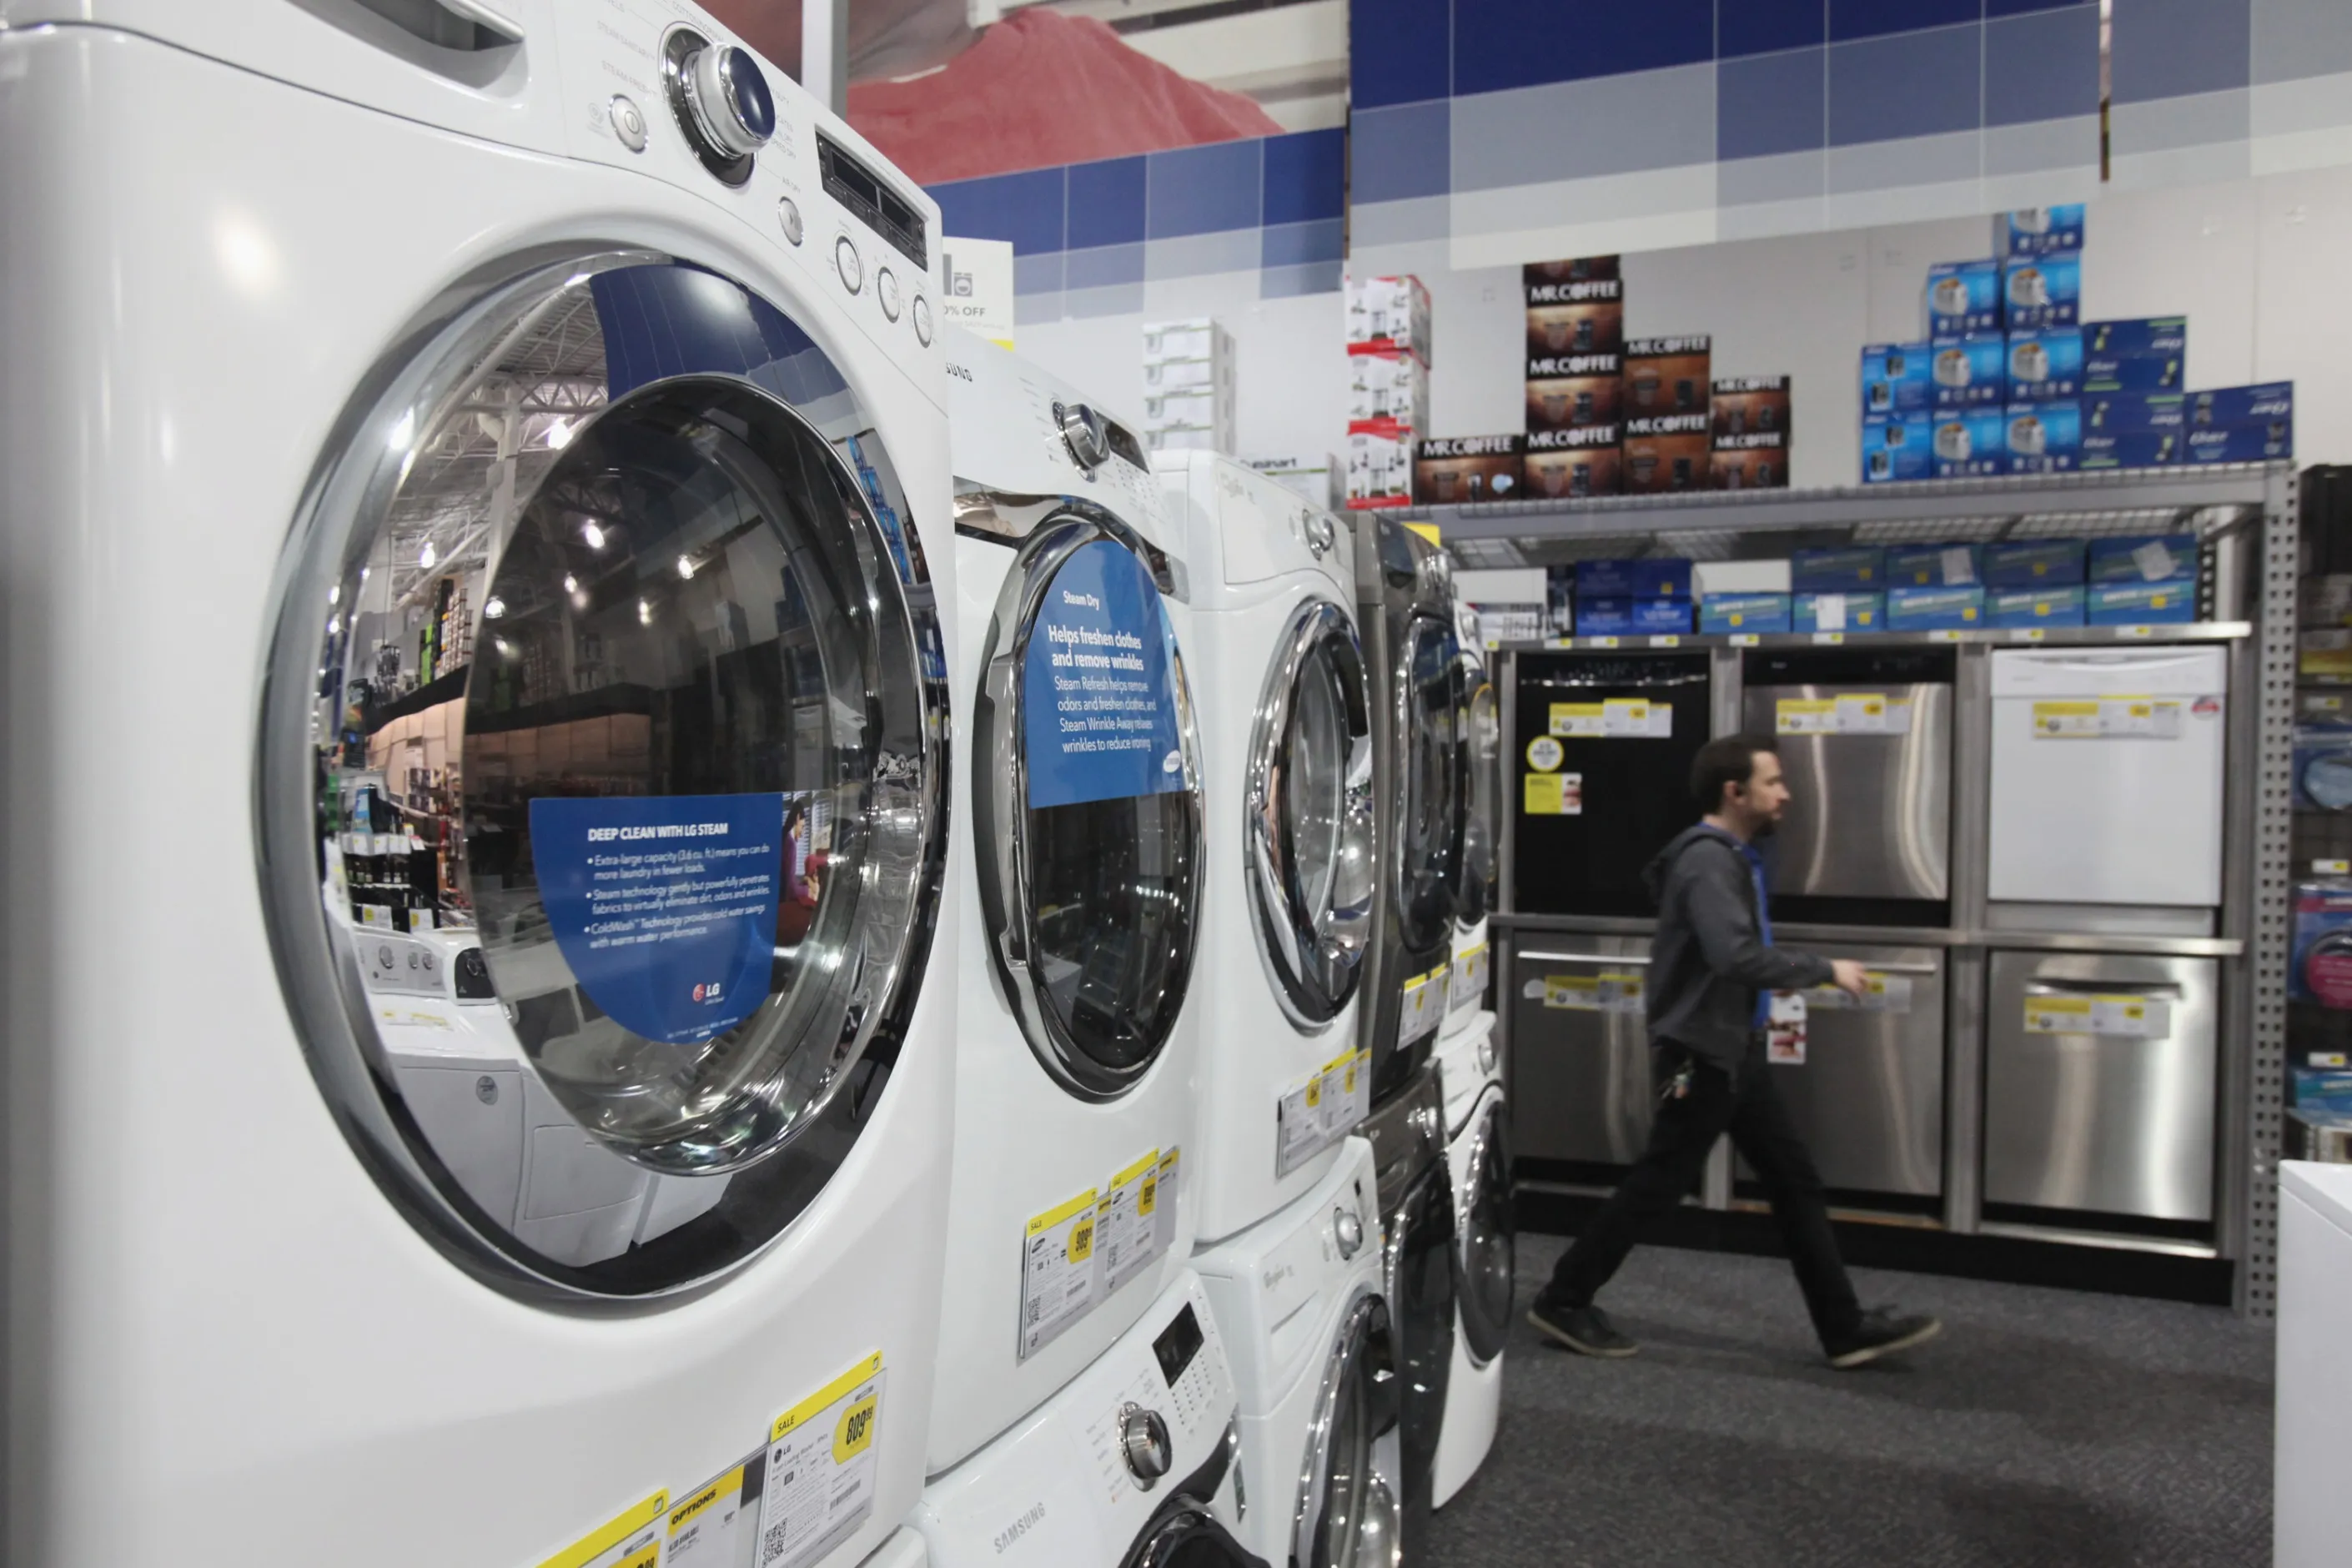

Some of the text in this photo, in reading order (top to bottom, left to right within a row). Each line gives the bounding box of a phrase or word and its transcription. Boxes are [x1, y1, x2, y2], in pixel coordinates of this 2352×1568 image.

[962, 306, 986, 317] OFF
[1063, 590, 1100, 611] Steam Dry
[1048, 624, 1142, 650] Helps freshen clothes
[1052, 648, 1144, 671] and remove wrinkles
[1054, 675, 1149, 694] Steam Refresh helps remove
[1057, 696, 1083, 711] odors
[1083, 696, 1098, 711] and
[1098, 696, 1124, 711] freshen
[1147, 698, 1157, 711] and
[1059, 716, 1153, 733] Steam Wrinkle Away relaxes
[1062, 735, 1151, 754] wrinkles to reduce ironing
[588, 823, 729, 842] DEEP CLEAN WITH LG STEAM
[594, 853, 642, 867] Extra-large
[644, 851, 676, 864] capacity
[716, 848, 736, 857] means
[737, 847, 750, 857] you
[761, 843, 770, 852] do
[594, 872, 618, 880] more
[620, 867, 651, 879] laundry
[653, 867, 661, 876] in
[661, 864, 683, 875] fewer
[593, 875, 770, 901] Steam technology gently but powerfully penetrates
[592, 903, 621, 915] fabrics
[623, 902, 632, 912] to
[633, 897, 665, 911] virtually
[666, 895, 698, 907] eliminate
[714, 891, 733, 902] odors
[733, 887, 746, 898] and
[641, 915, 682, 930] Technology
[683, 910, 712, 925] provides
[711, 907, 728, 918] cold
[728, 907, 745, 916] water
[745, 903, 766, 914] savings
[590, 936, 610, 948] with
[611, 936, 636, 946] warm
[636, 933, 658, 943] water
[706, 983, 721, 997] LG
[1030, 1219, 1042, 1231] SALE
[777, 1415, 795, 1434] SALE
[783, 1444, 792, 1455] LG
[671, 1488, 716, 1525] OPTIONS
[993, 1501, 1045, 1555] SAMSUNG
